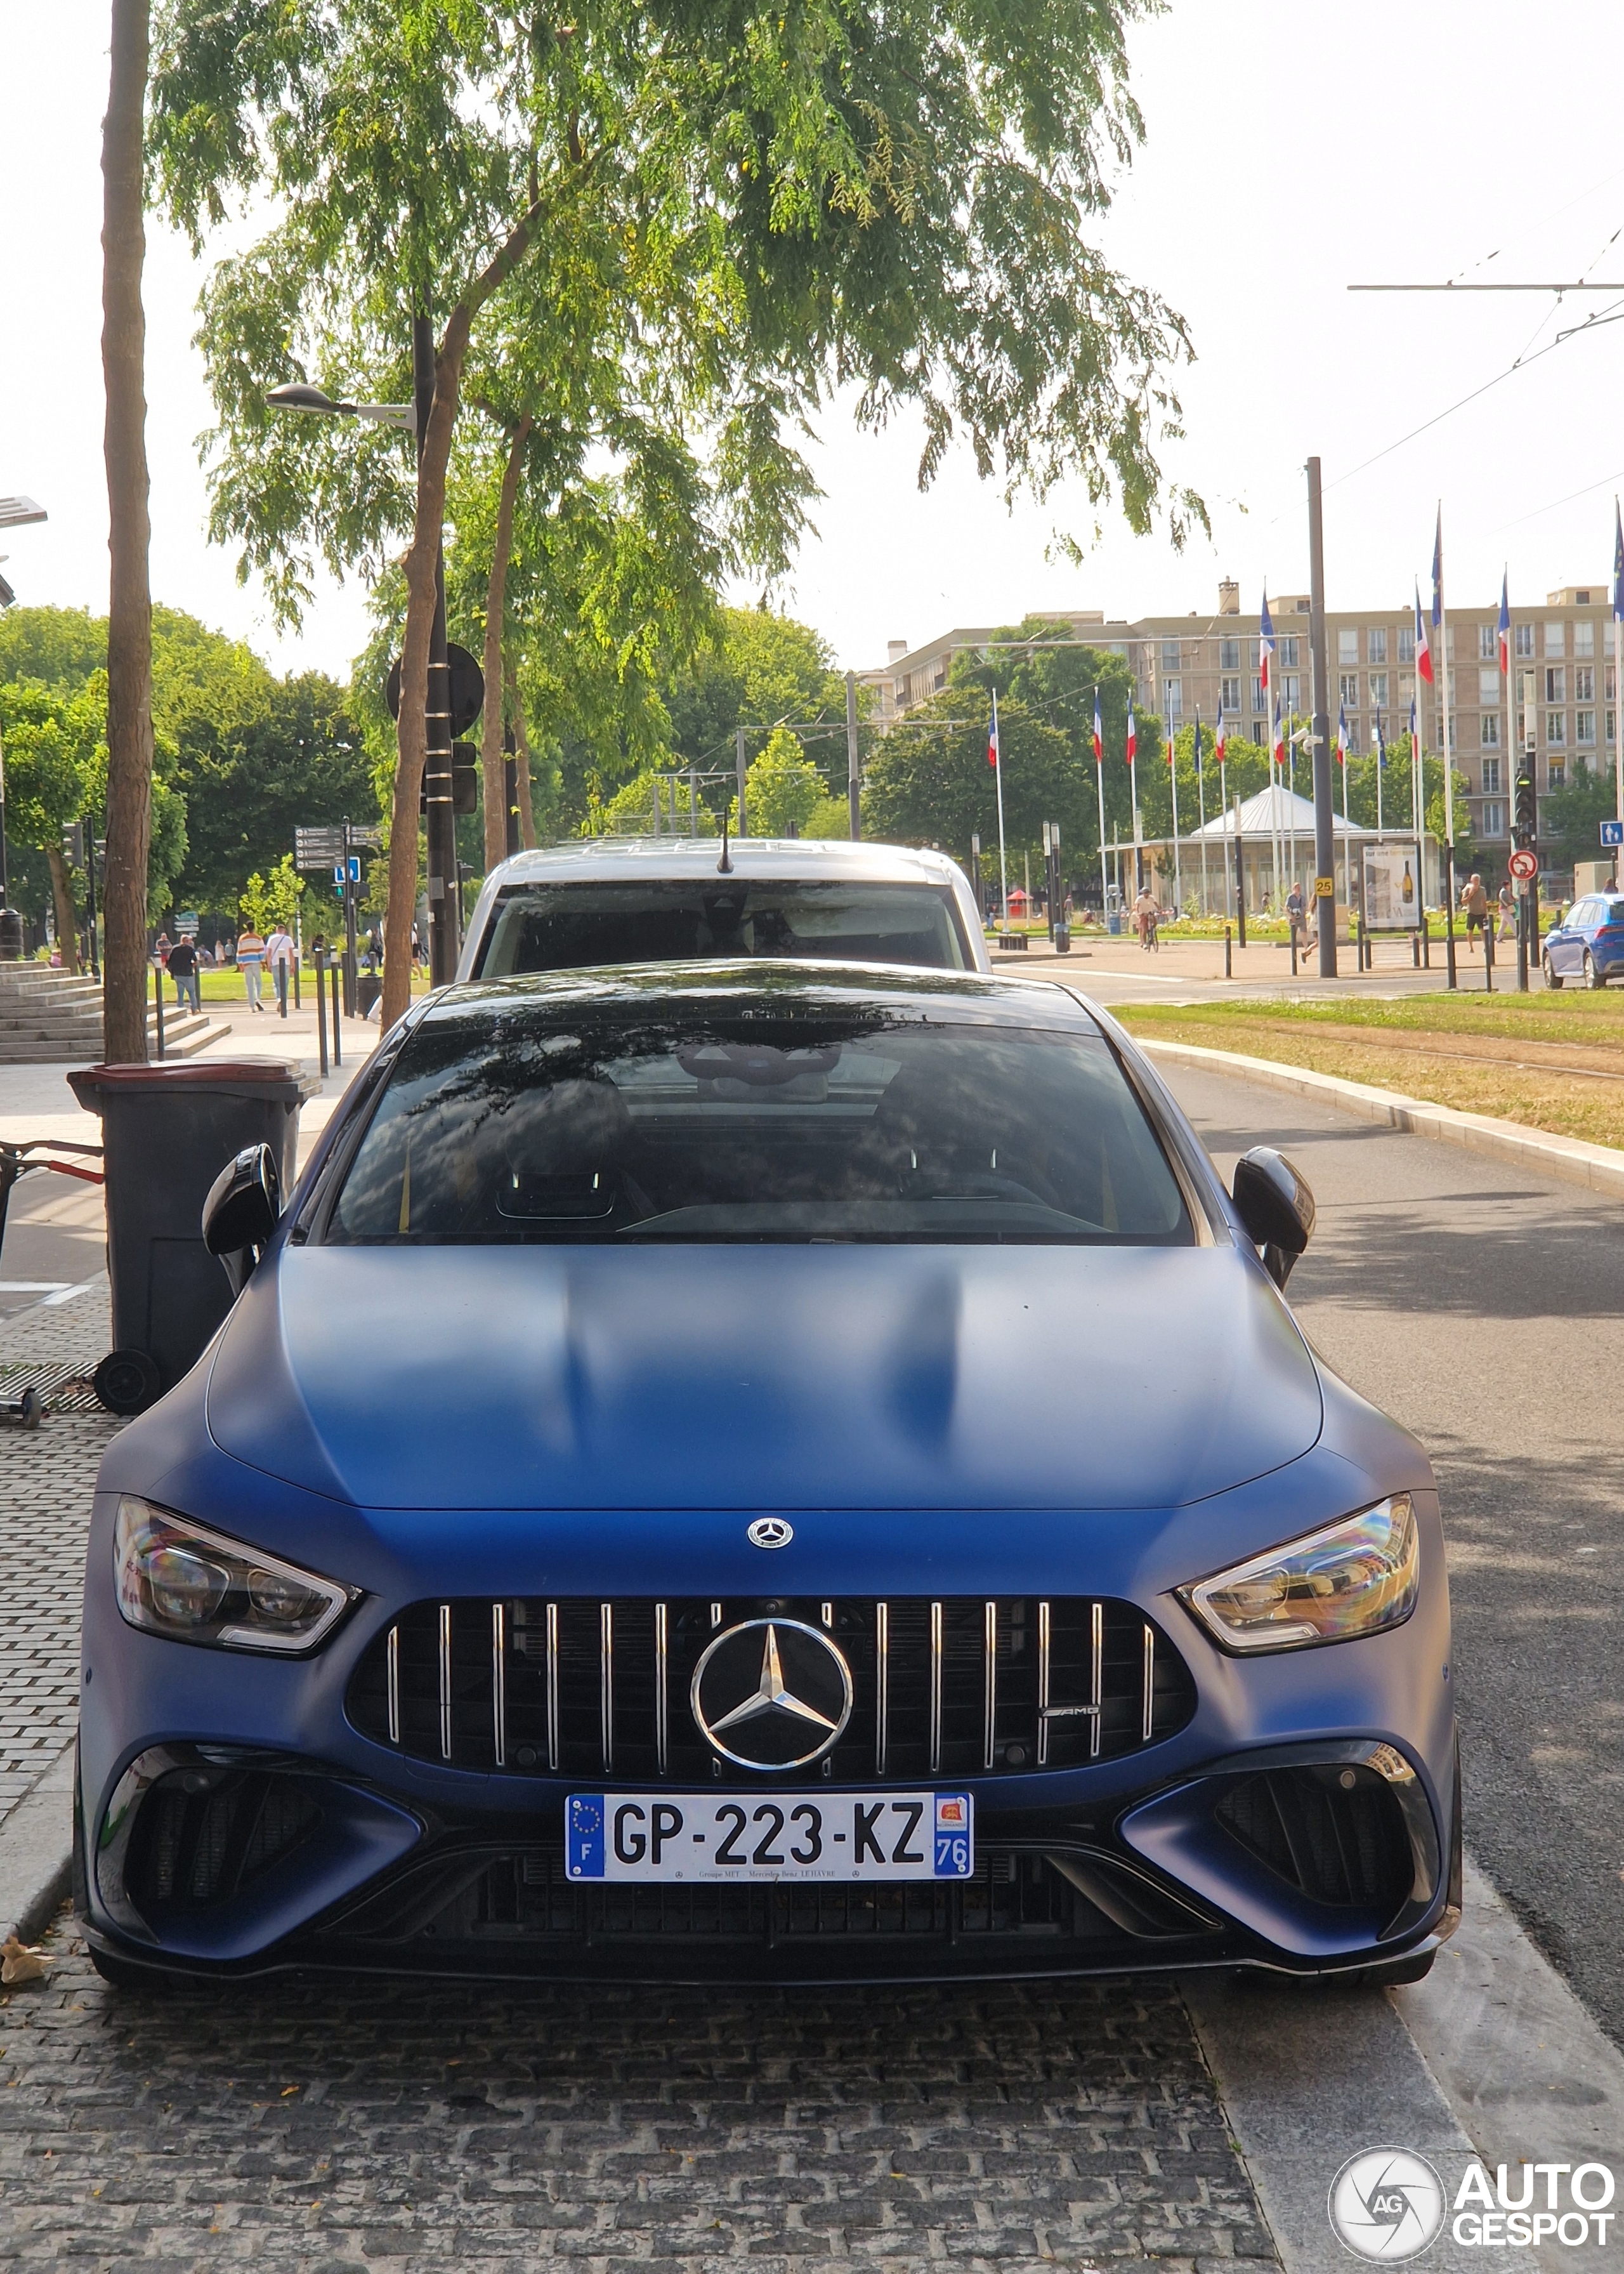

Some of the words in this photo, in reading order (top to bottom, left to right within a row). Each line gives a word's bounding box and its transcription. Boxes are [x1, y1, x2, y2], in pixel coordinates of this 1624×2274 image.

[1317, 882, 1331, 891] 25
[1060, 1707, 1099, 1716] AMG
[613, 1801, 924, 1865] GP-223-KZ
[581, 1843, 592, 1860] F
[937, 1839, 967, 1865] 76
